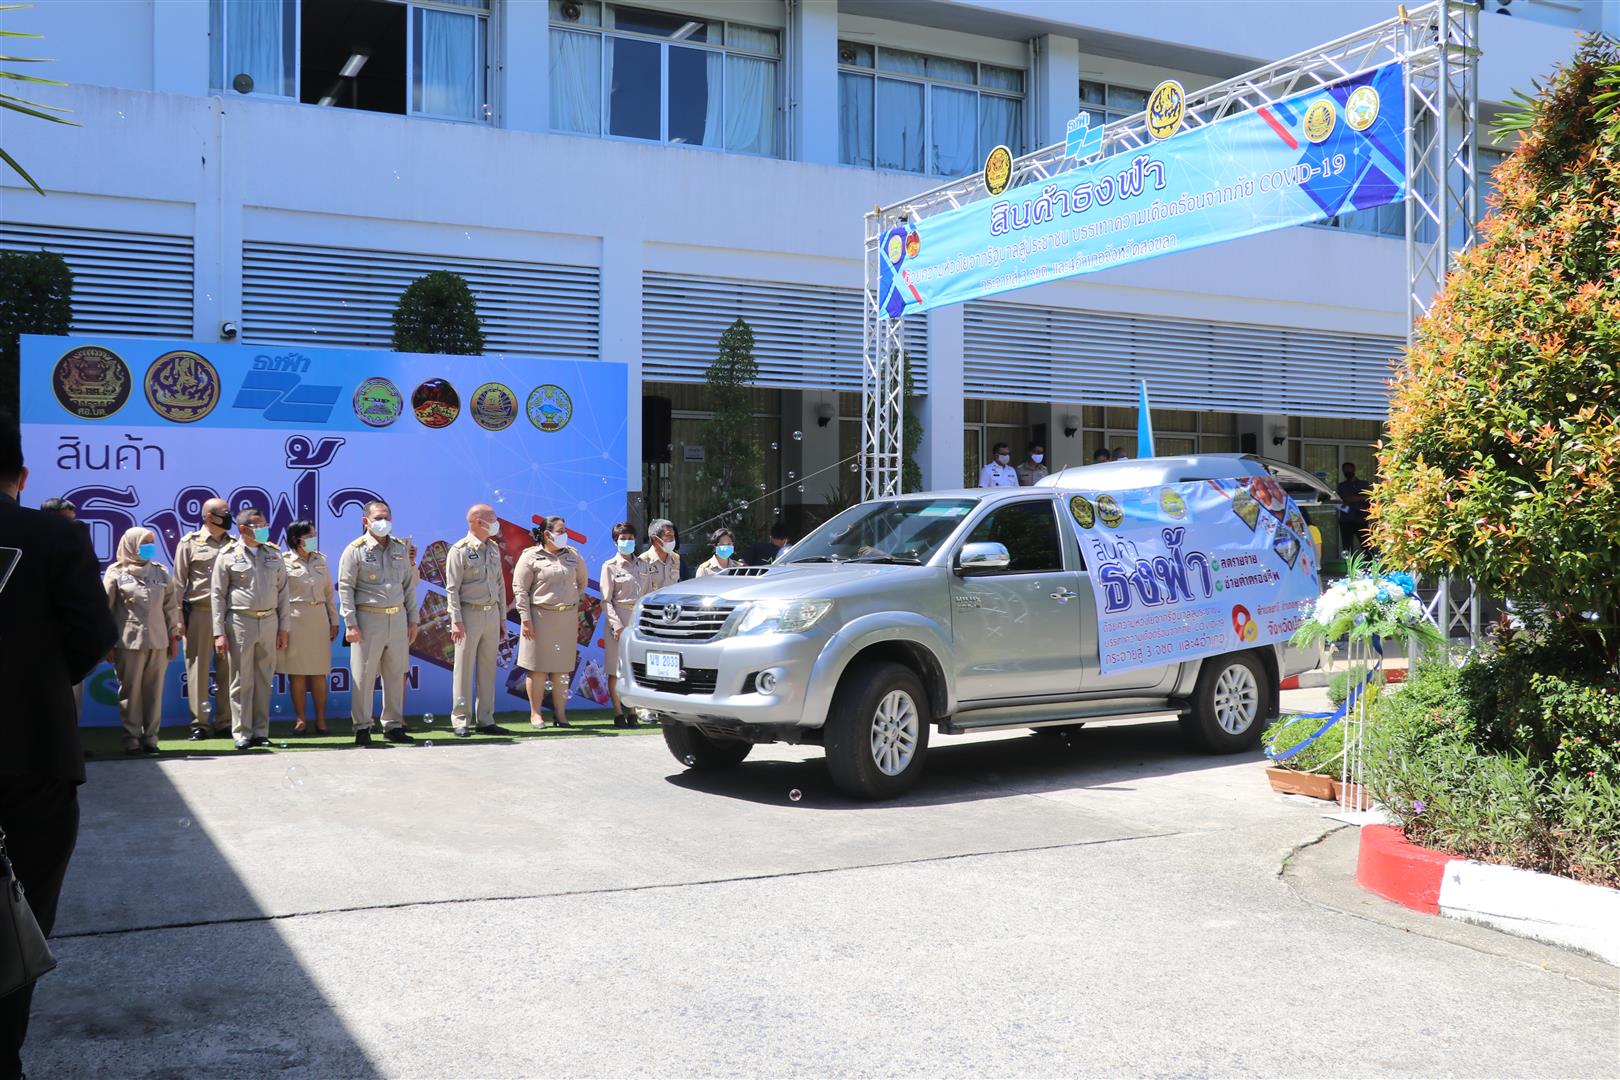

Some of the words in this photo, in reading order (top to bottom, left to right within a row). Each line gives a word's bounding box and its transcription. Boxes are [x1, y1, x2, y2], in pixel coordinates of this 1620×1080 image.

[1259, 153, 1346, 193] COVID-19
[989, 155, 1167, 237] สินค้าธงฟ้า
[252, 353, 311, 373] ธงฟ้า
[57, 434, 165, 470] สินค้า
[1091, 534, 1140, 561] สินค้า
[1099, 527, 1214, 614] ธงฟ้า
